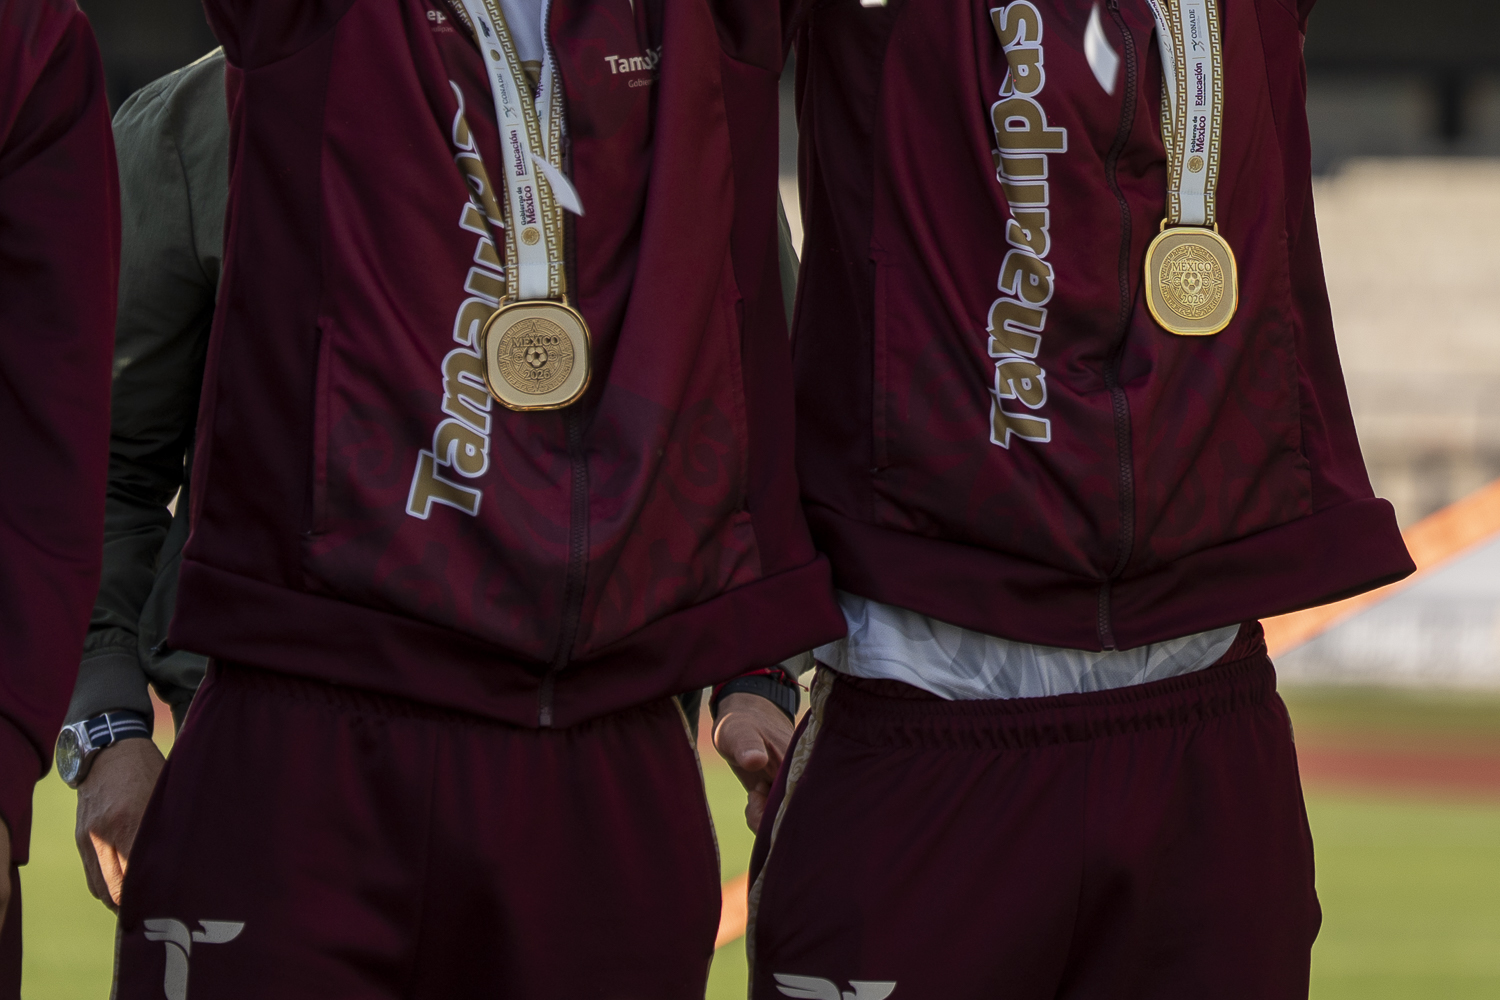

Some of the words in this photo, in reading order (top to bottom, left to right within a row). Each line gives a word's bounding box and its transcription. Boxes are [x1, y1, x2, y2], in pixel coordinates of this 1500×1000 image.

[1188, 9, 1197, 39] CONADE
[1195, 62, 1203, 106] Educación
[509, 129, 524, 177] Educación
[1195, 115, 1206, 153] México
[523, 185, 537, 225] México
[1182, 294, 1204, 304] 2026
[524, 369, 551, 380] 2026
